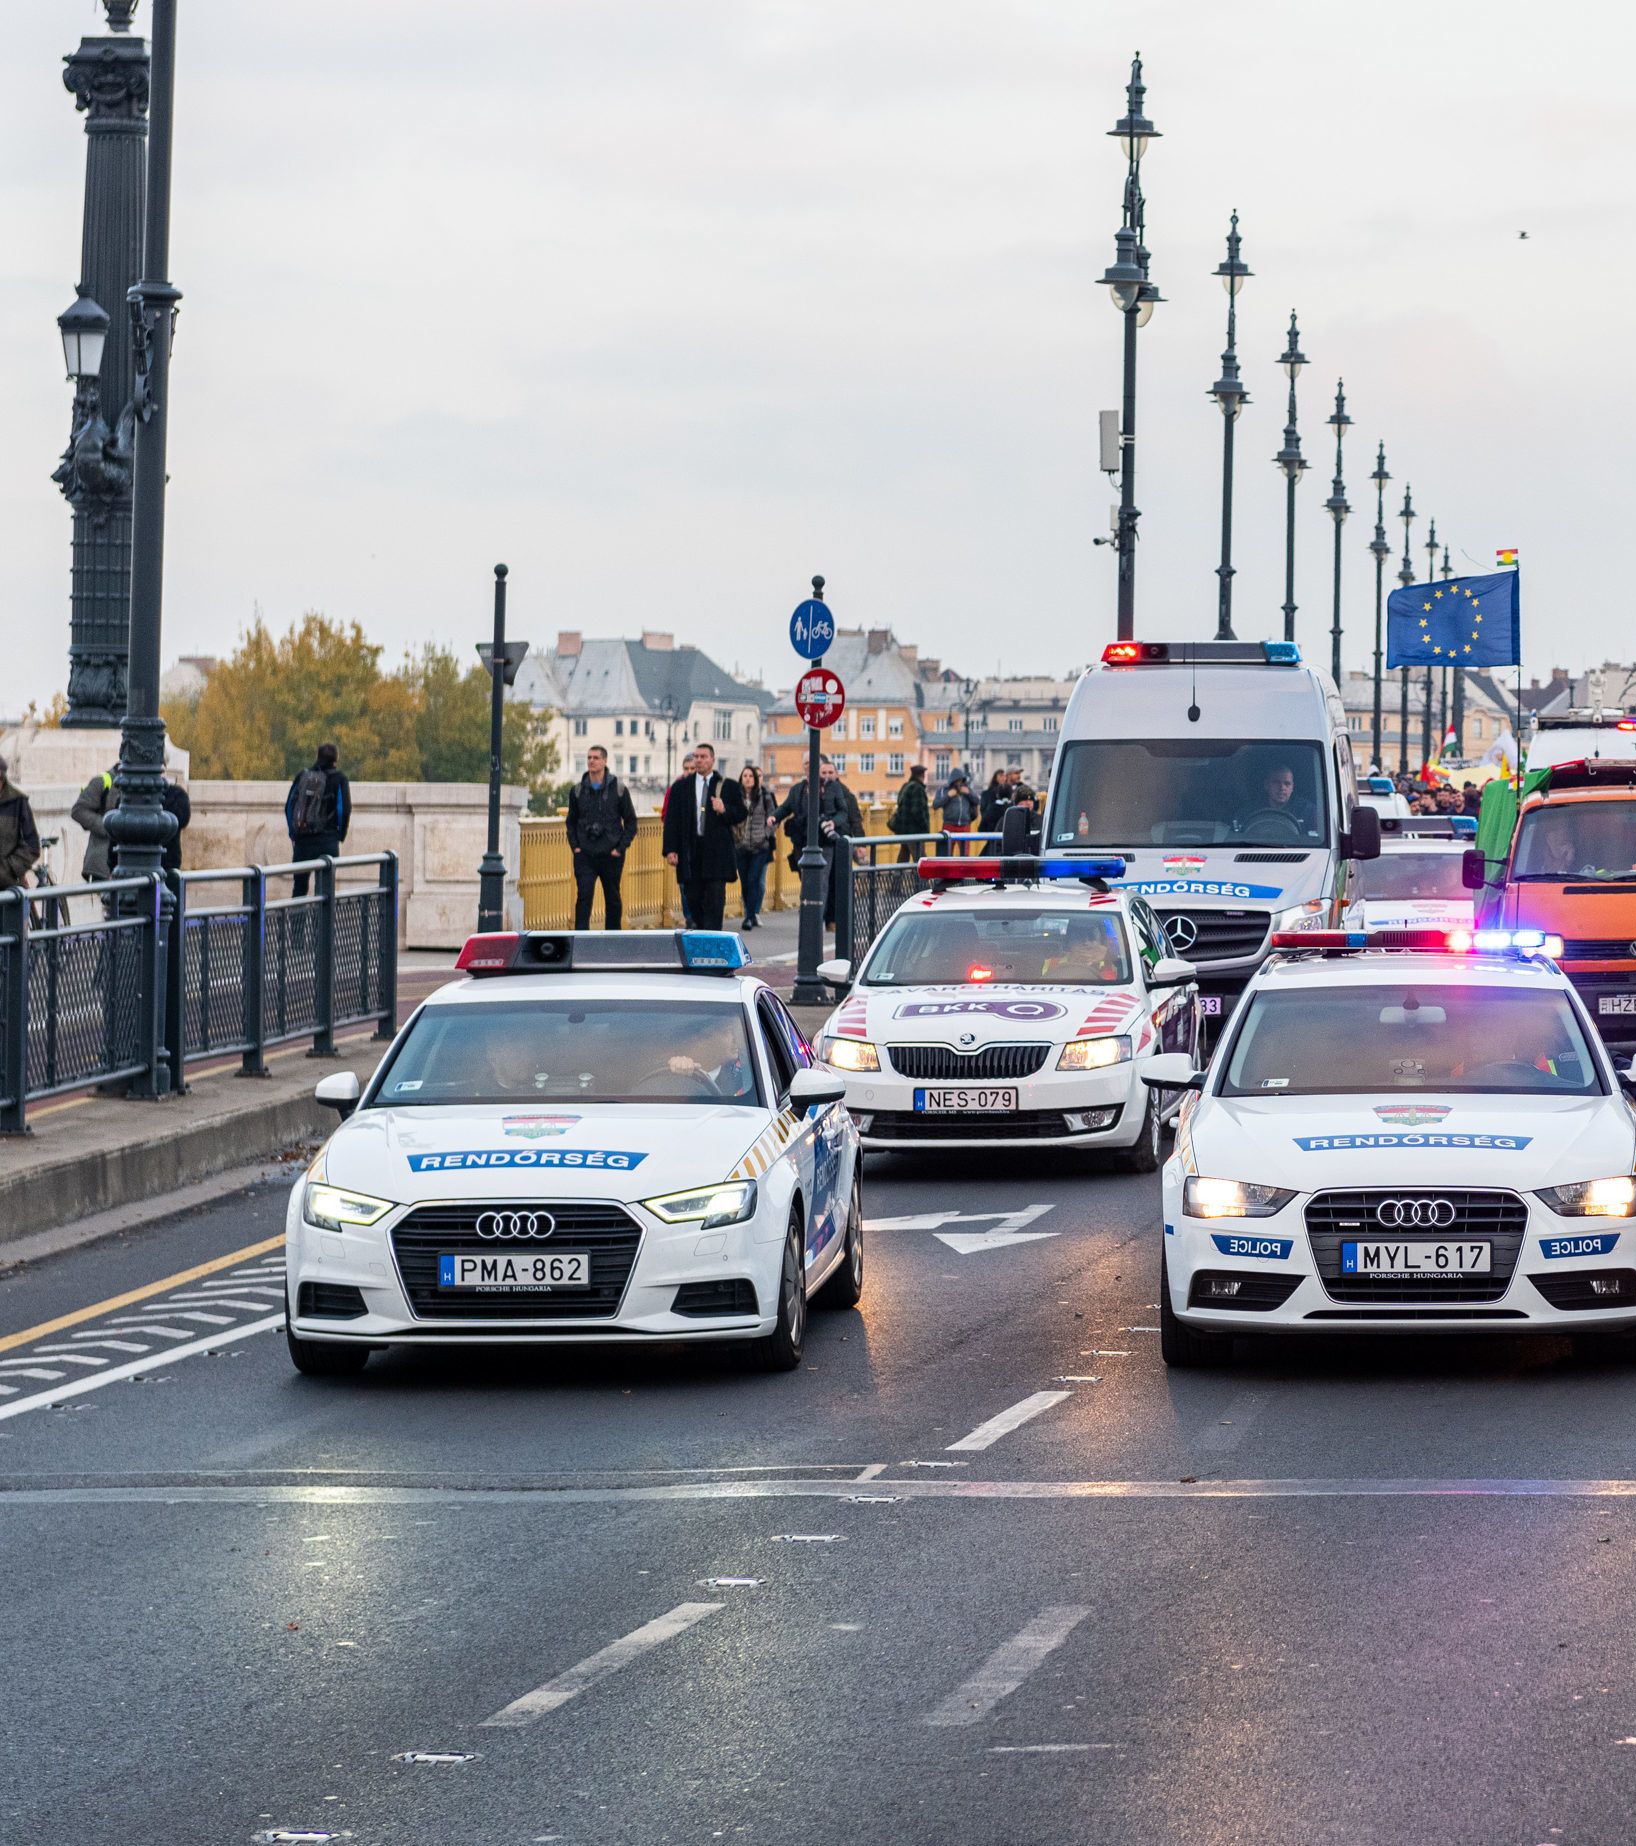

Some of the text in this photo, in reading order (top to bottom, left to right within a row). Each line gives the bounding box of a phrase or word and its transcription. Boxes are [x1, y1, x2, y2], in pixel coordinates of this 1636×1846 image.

[918, 1002, 988, 1014] BKK
[929, 1091, 1012, 1108] NES-079
[1309, 1133, 1517, 1149] RENDŐRSÉG
[420, 1150, 631, 1169] RENDŐRSÉG
[1346, 1260, 1354, 1268] H
[1363, 1245, 1484, 1269] MYL-617
[444, 1273, 451, 1281] H
[460, 1258, 582, 1282] PMA-862
